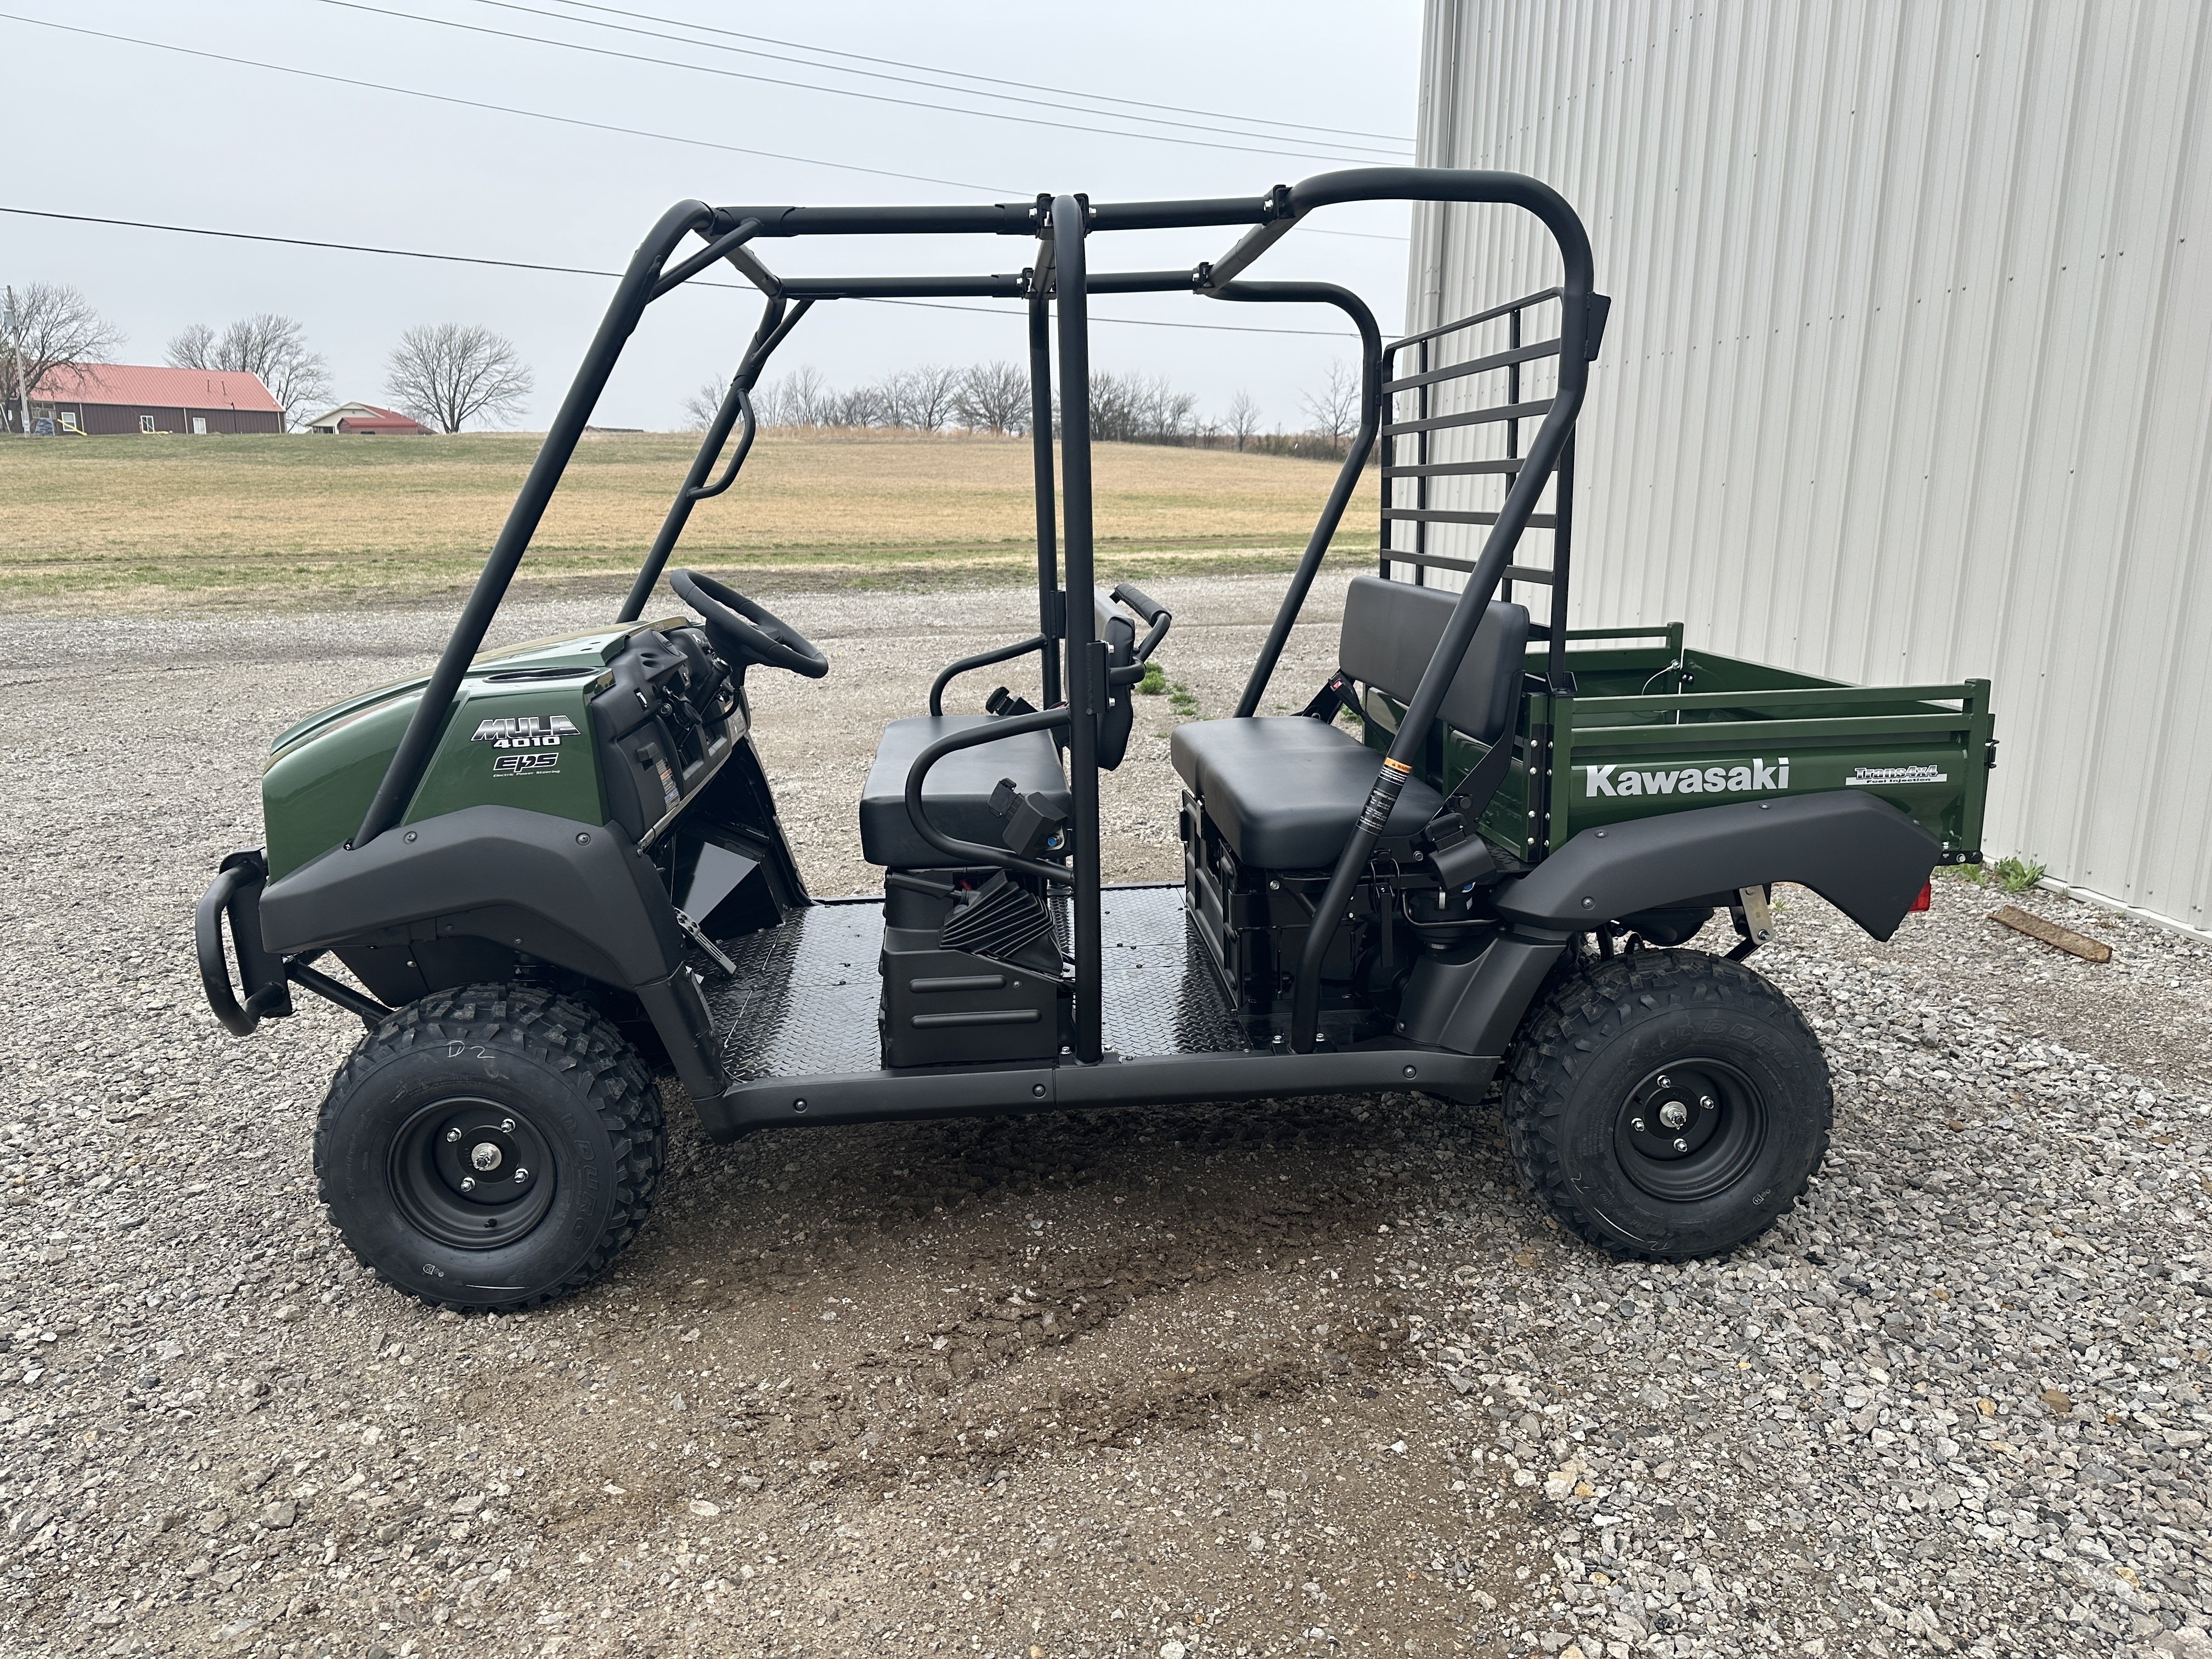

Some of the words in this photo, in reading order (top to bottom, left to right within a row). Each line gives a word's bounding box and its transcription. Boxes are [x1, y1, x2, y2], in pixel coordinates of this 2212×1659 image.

[471, 715, 581, 741] MULE
[493, 736, 560, 748] 4010
[493, 752, 559, 772] EPS
[1586, 757, 1790, 797] Kawasaki
[1855, 765, 1938, 780] Trans4x4
